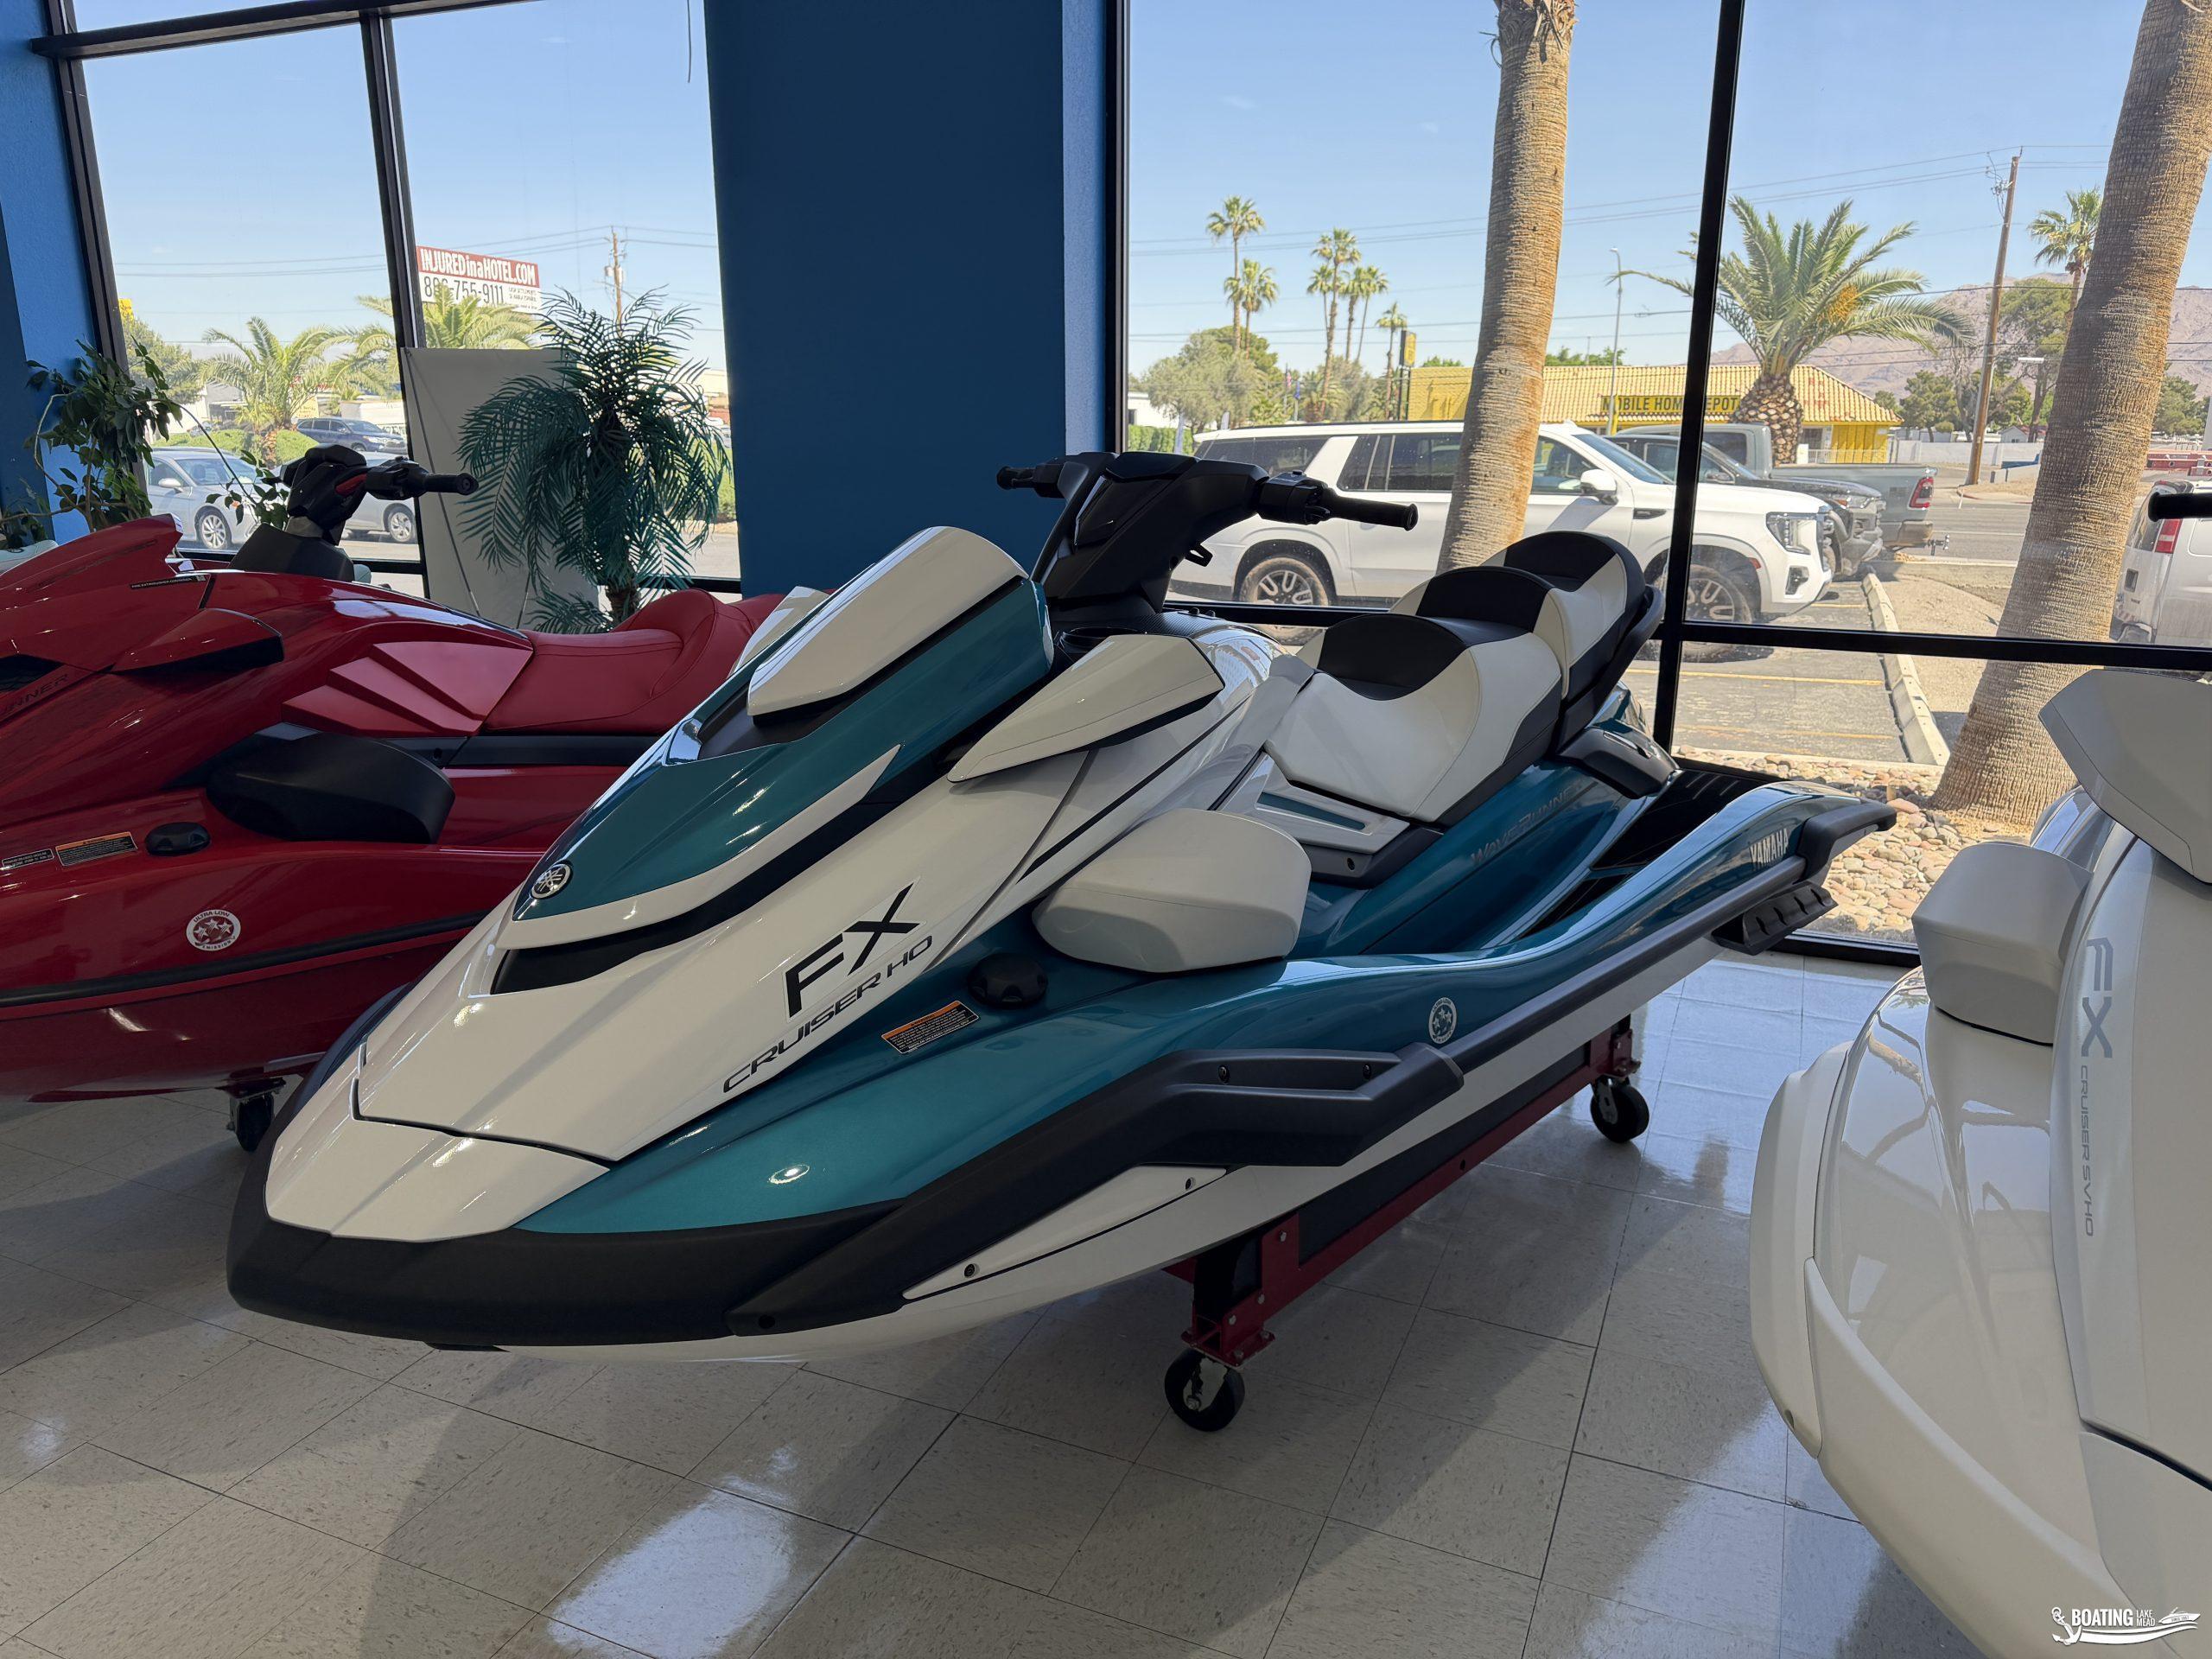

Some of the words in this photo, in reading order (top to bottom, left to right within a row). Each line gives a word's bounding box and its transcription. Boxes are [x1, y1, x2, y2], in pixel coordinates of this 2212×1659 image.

[1654, 397, 1684, 410] HOM
[1706, 397, 1736, 410] EPOT
[1749, 828, 1789, 864] YAMAHA
[785, 882, 921, 1019] FX
[2081, 937, 2113, 1058] FX
[723, 972, 881, 1094] CRUISER
[887, 935, 933, 978] HO
[2081, 1065, 2090, 1161] CRUISER
[2082, 1164, 2094, 1237] SVHO
